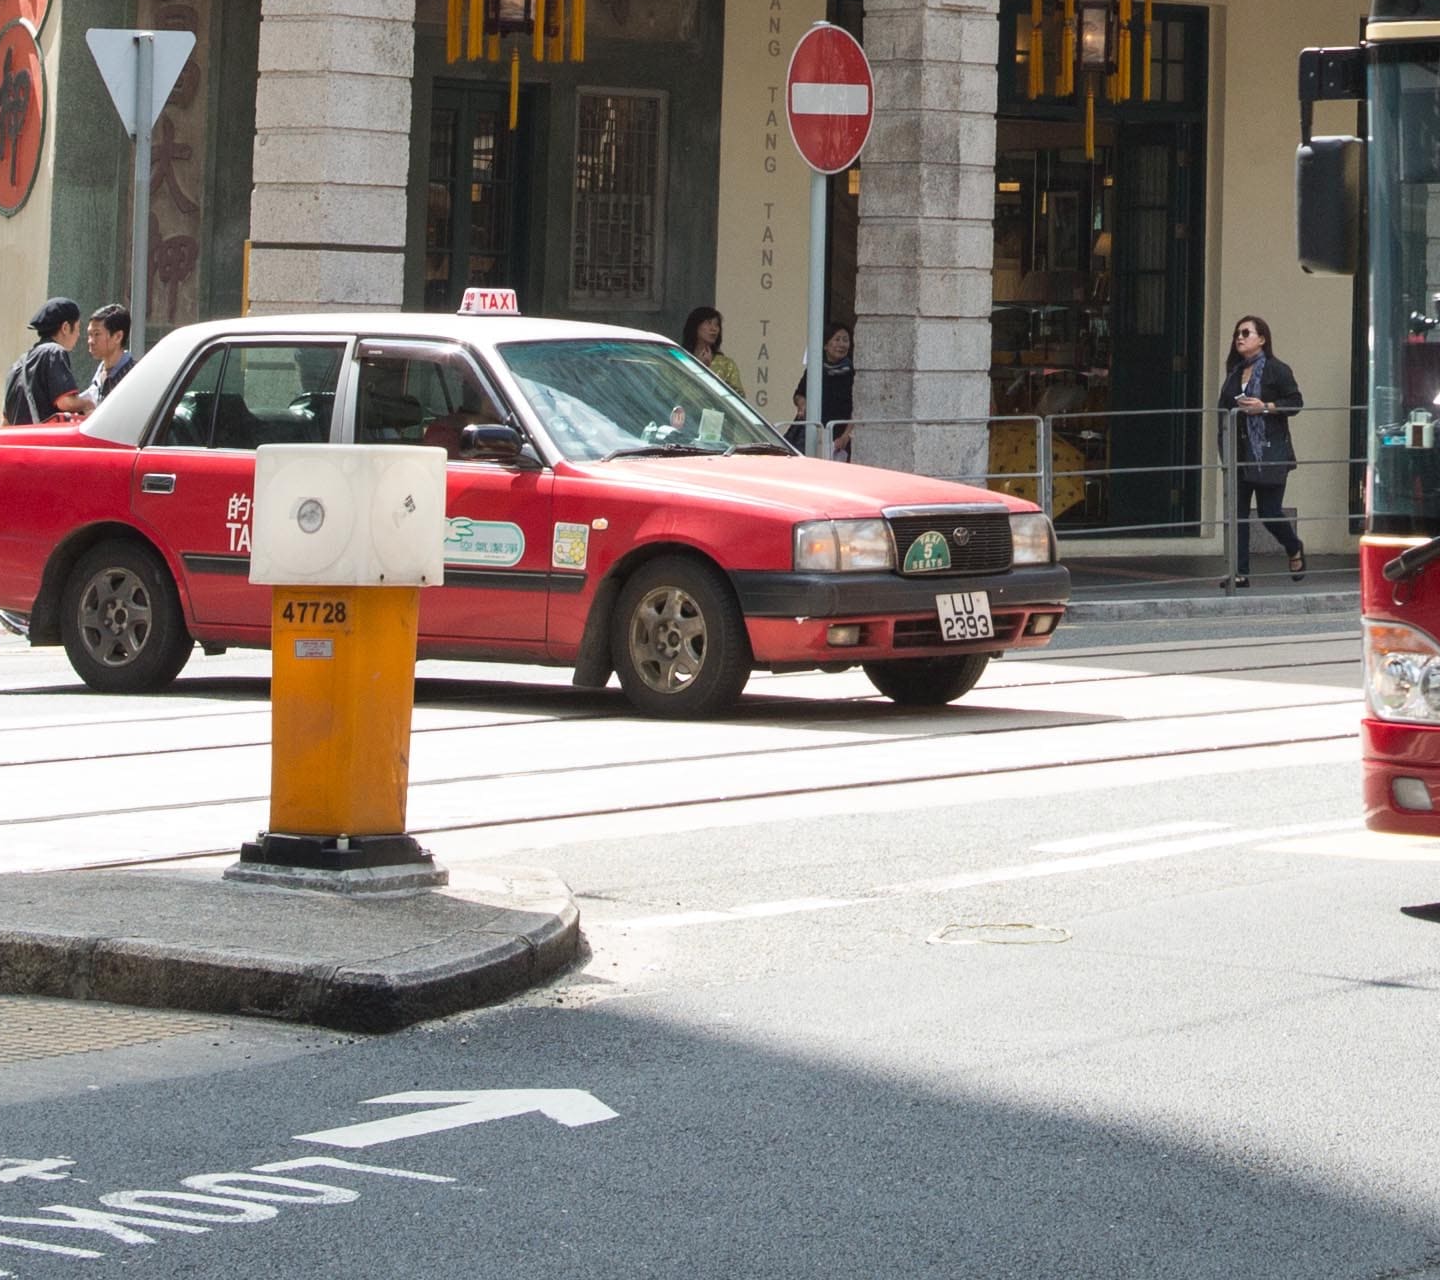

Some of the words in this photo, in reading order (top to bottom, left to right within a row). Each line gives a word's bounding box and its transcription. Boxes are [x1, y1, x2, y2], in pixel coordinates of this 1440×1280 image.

[764, 87, 778, 174] TANG
[760, 203, 775, 290] TANG
[480, 293, 515, 310] TAXI
[755, 321, 770, 408] TANG
[226, 493, 253, 521] 的
[918, 535, 941, 545] TAXI
[923, 543, 933, 559] 5
[912, 559, 943, 570] SEATS
[282, 602, 347, 623] 47728
[951, 592, 975, 616] LU
[944, 615, 990, 640] 2393
